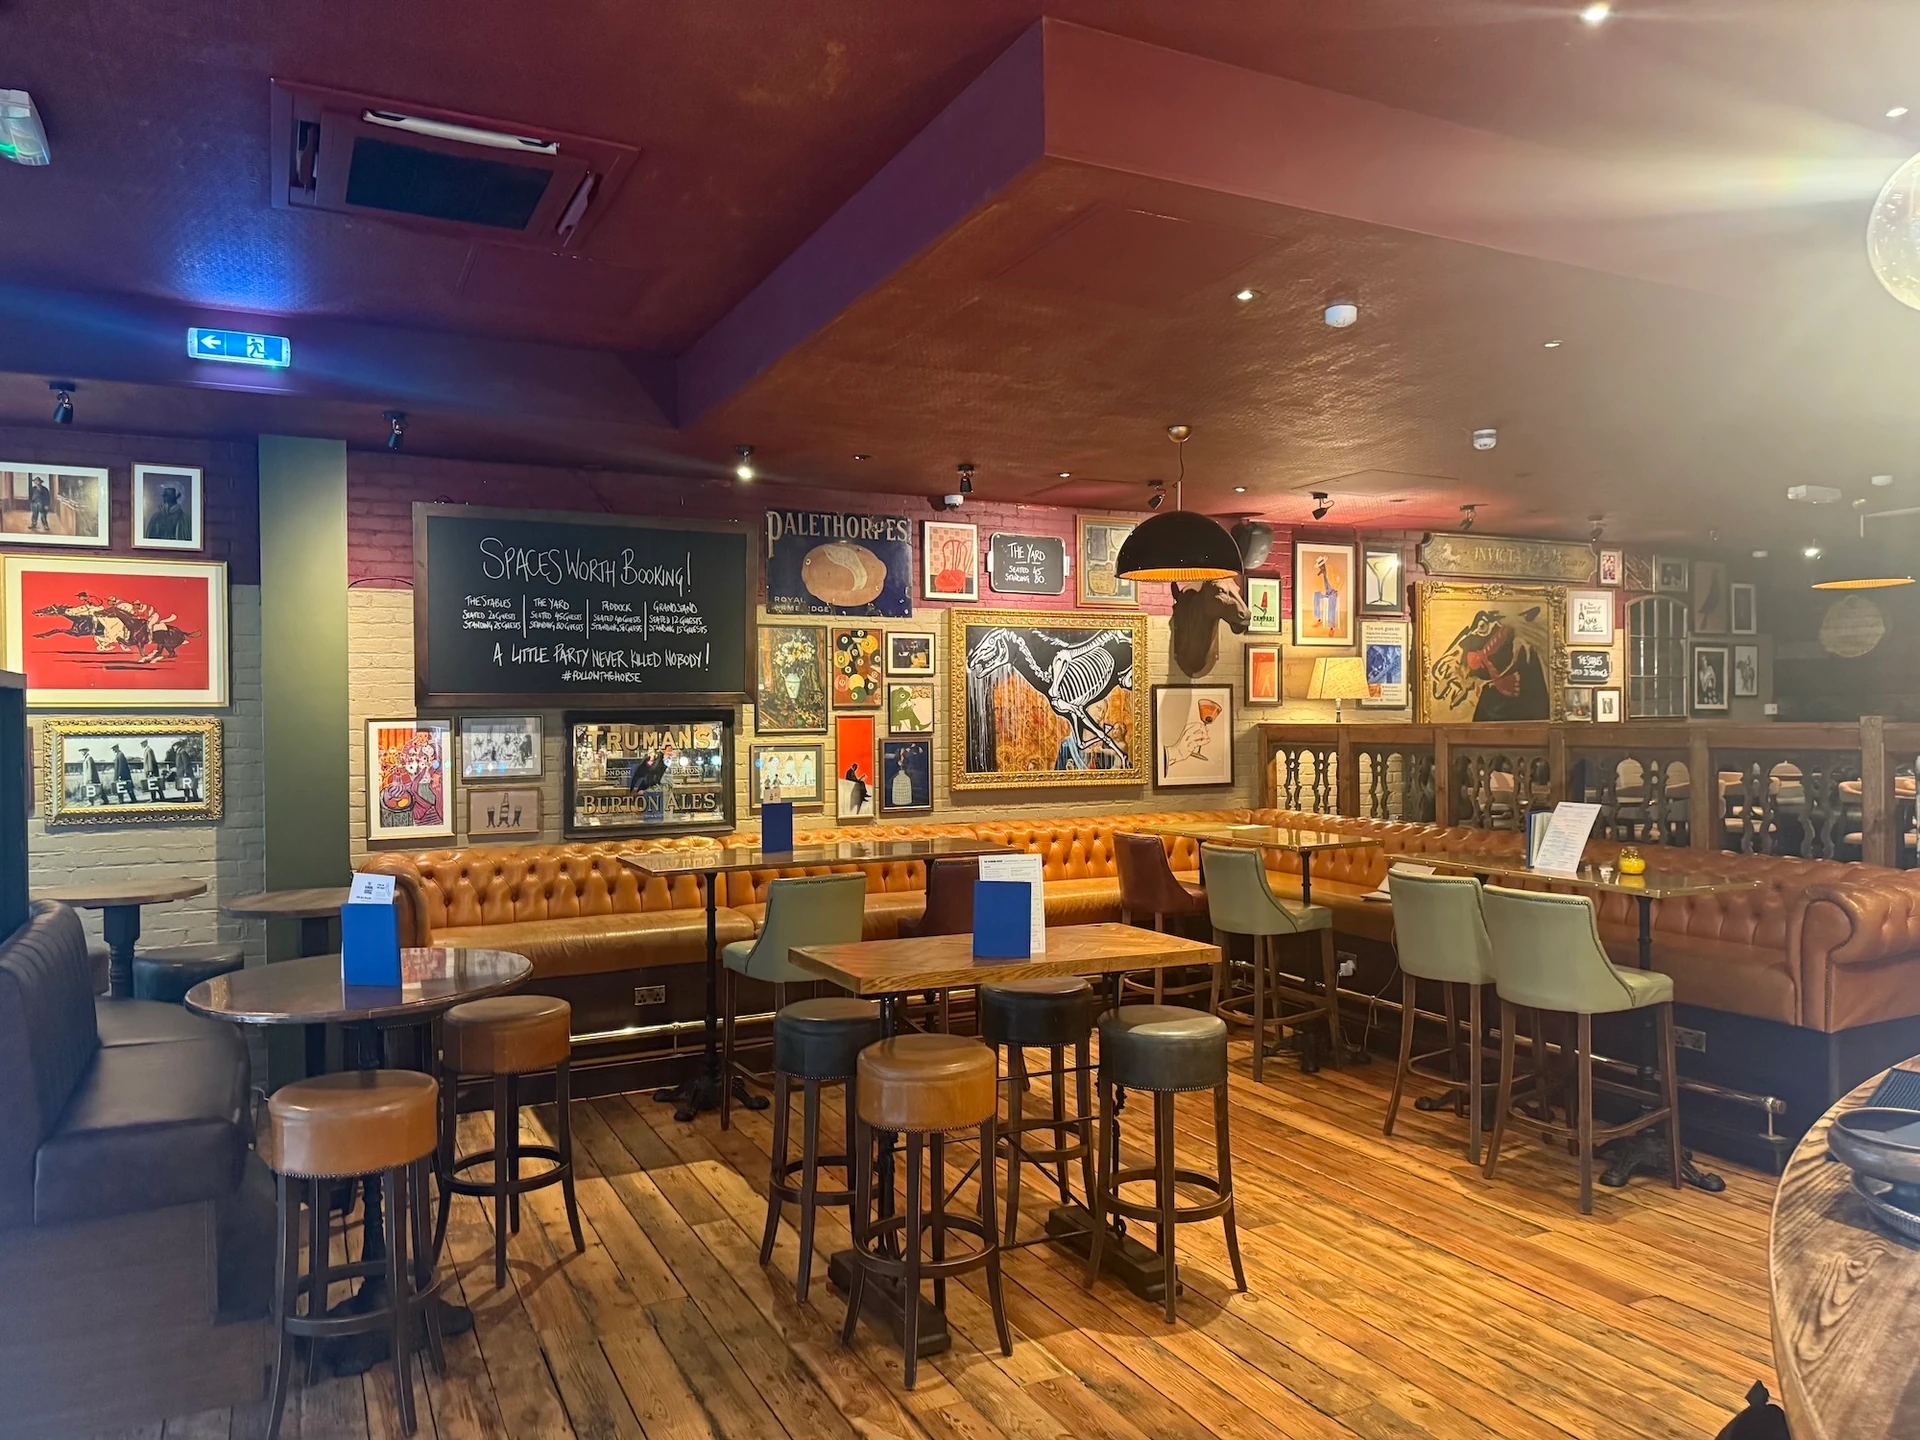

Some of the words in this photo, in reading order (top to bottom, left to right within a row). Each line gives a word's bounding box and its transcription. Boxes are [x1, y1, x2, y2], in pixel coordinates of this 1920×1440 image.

[767, 510, 908, 558] PALETHORPES
[1007, 542, 1025, 559] THE
[1026, 544, 1046, 563] YARD
[480, 537, 562, 586] SPACES
[565, 548, 616, 588] WORTH
[620, 548, 691, 597] BOOKING!
[465, 595, 481, 606] THE
[533, 598, 547, 607] THE
[548, 598, 570, 610] YARD
[601, 600, 632, 613] PADDOCK
[462, 609, 486, 620] SEATED
[648, 614, 670, 625] SEATED
[492, 642, 503, 666] A
[511, 643, 550, 664] LITTLE
[553, 643, 590, 667] PARTY
[591, 648, 628, 668] NEVER
[630, 649, 662, 668] KILLED
[586, 729, 712, 751] TRUMANS
[583, 795, 660, 815] BURTON
[664, 792, 716, 812] ALES
